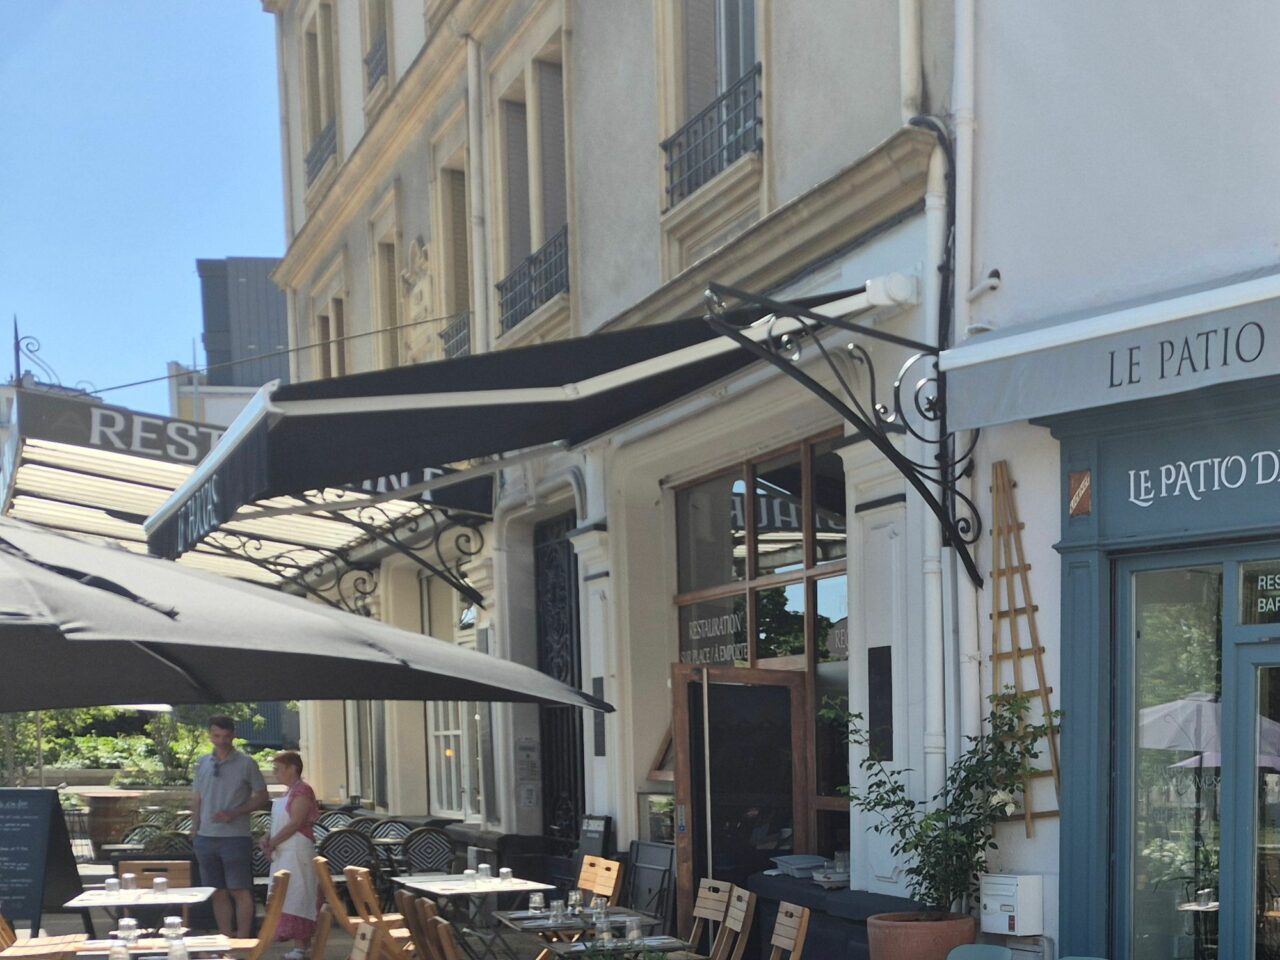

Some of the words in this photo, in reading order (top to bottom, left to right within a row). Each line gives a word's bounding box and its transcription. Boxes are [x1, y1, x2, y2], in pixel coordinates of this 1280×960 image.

[1108, 346, 1142, 389] LE
[1158, 320, 1265, 380] PATIO
[1128, 469, 1155, 507] LE
[1159, 455, 1247, 501] PATIO
[688, 611, 742, 639] RESTAURATION
